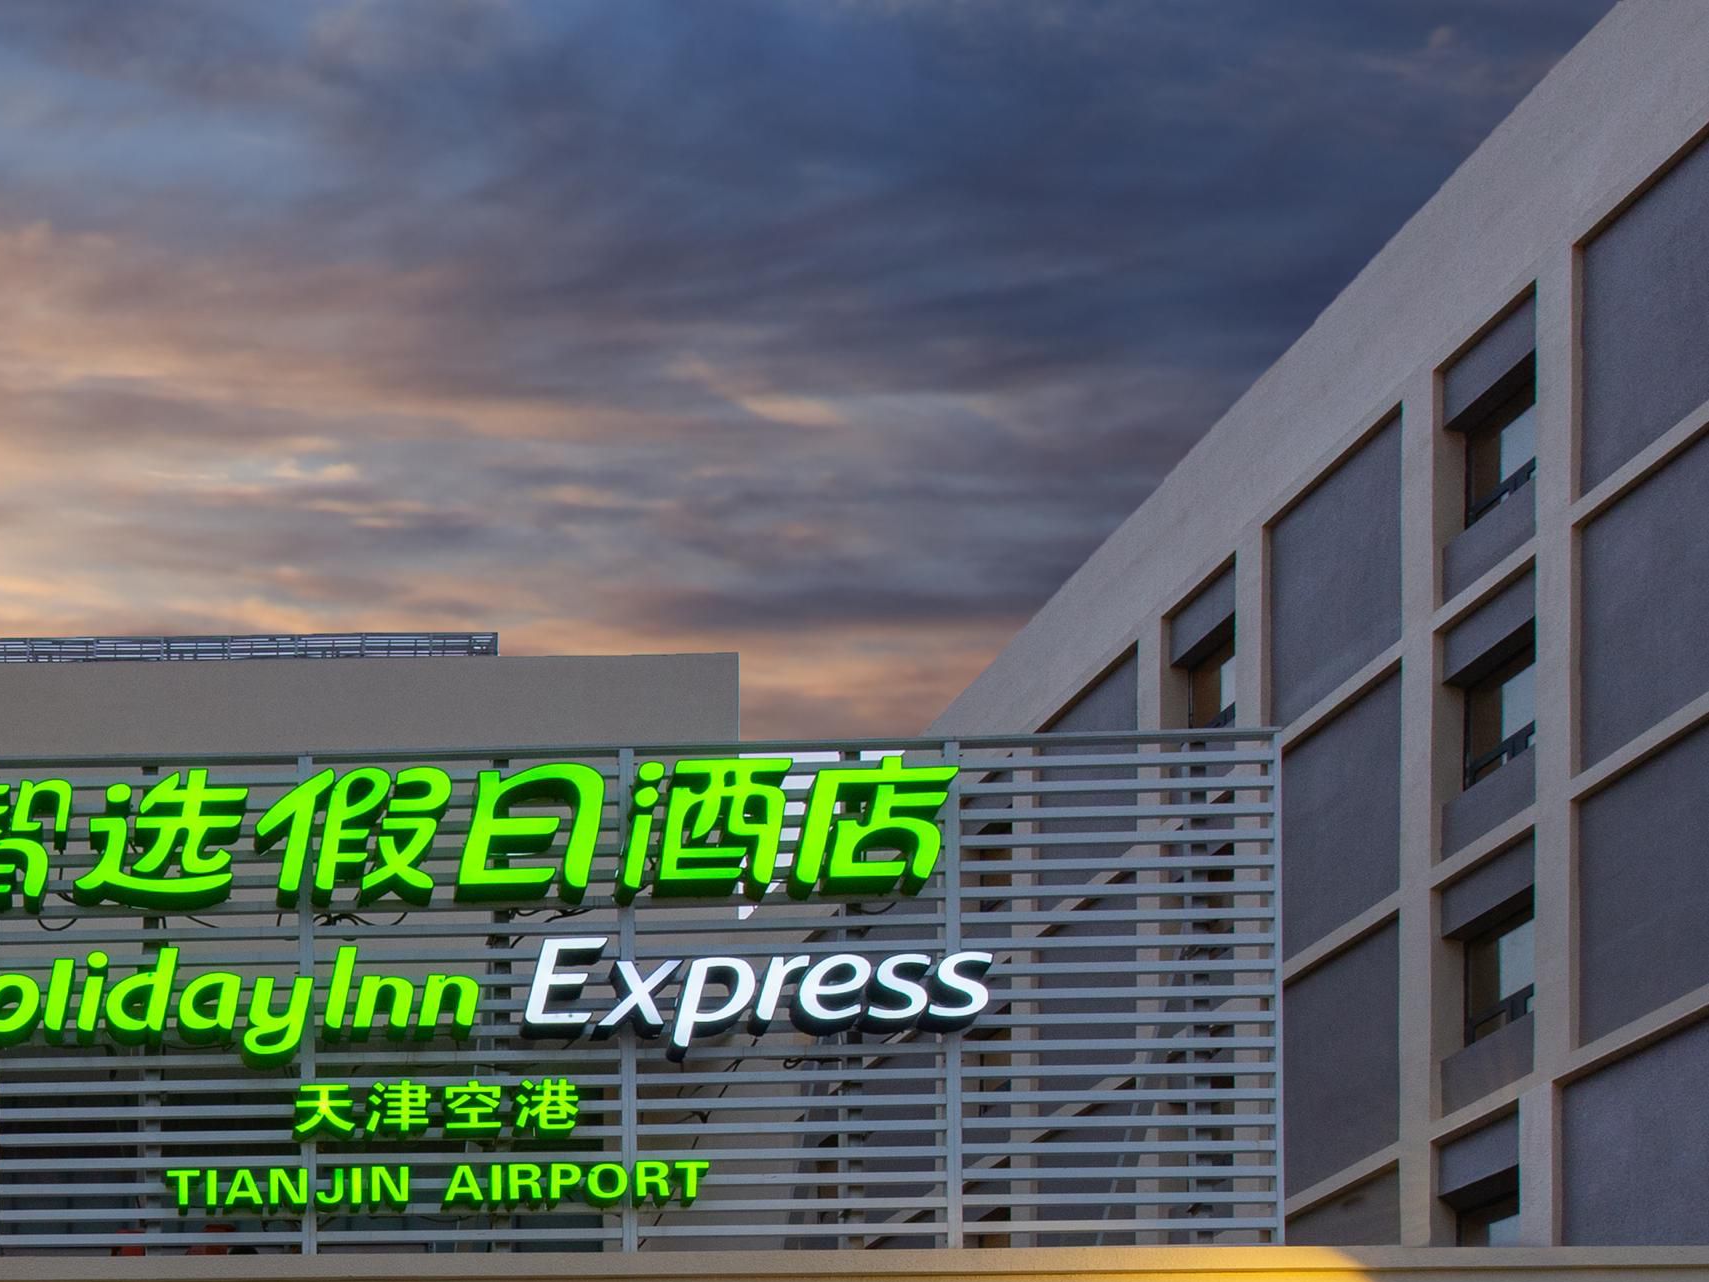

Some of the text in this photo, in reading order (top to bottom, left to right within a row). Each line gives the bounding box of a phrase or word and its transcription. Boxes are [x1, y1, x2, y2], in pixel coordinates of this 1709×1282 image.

[524, 937, 994, 1054] Express
[295, 1078, 580, 1134] 天津空港
[166, 1160, 710, 1207] TIANJIN AIRPORT
